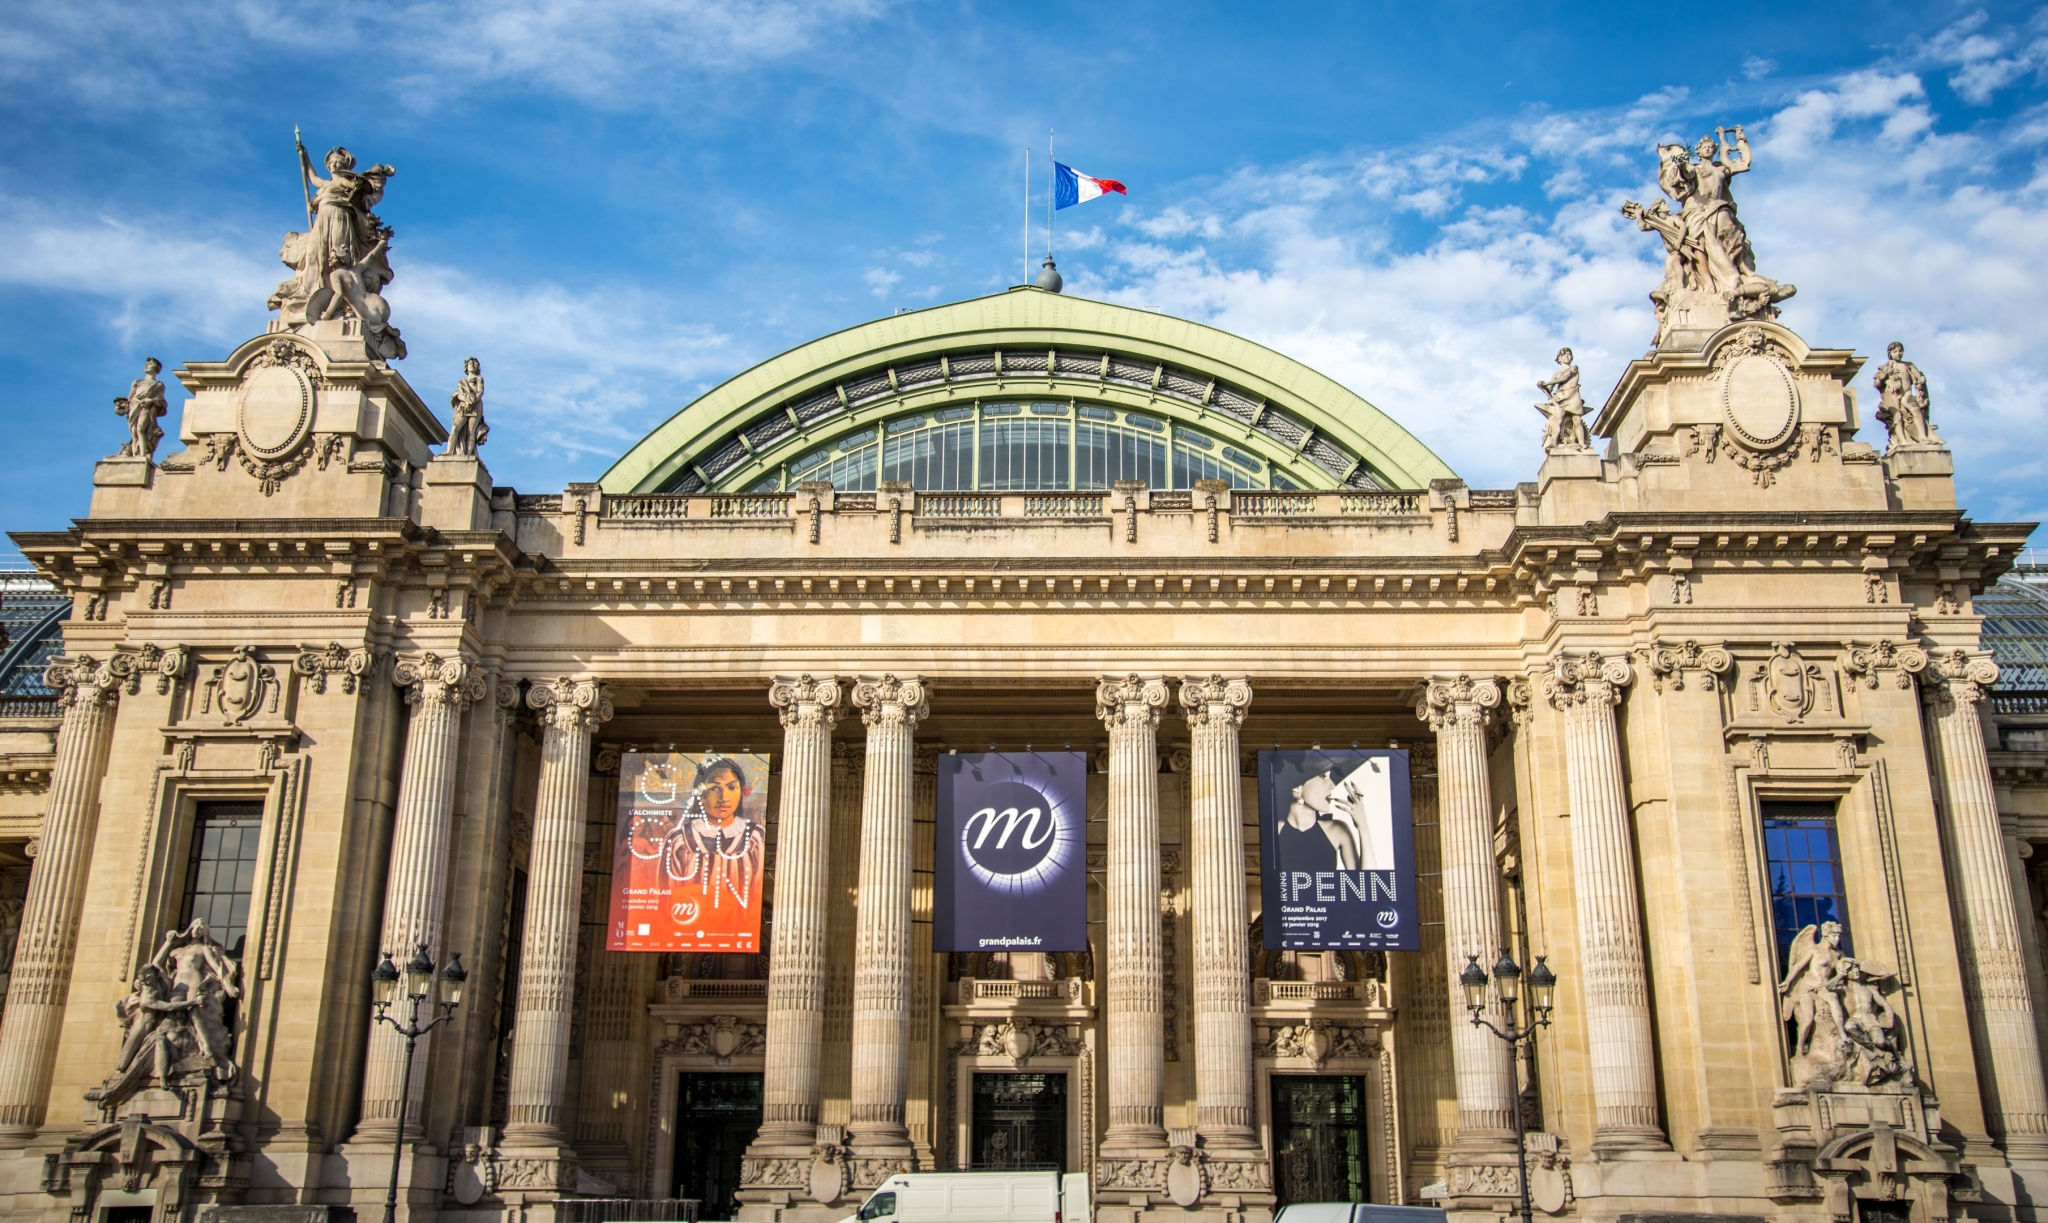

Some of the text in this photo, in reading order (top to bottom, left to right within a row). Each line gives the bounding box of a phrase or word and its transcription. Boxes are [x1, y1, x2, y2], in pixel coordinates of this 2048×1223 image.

[622, 887, 672, 895] GRAND PALAIS
[1280, 871, 1288, 902] IRVING
[1291, 871, 1397, 902] PENN
[1281, 905, 1327, 913] GRAND PALAIS
[978, 936, 1043, 948] grandpalais.fr
